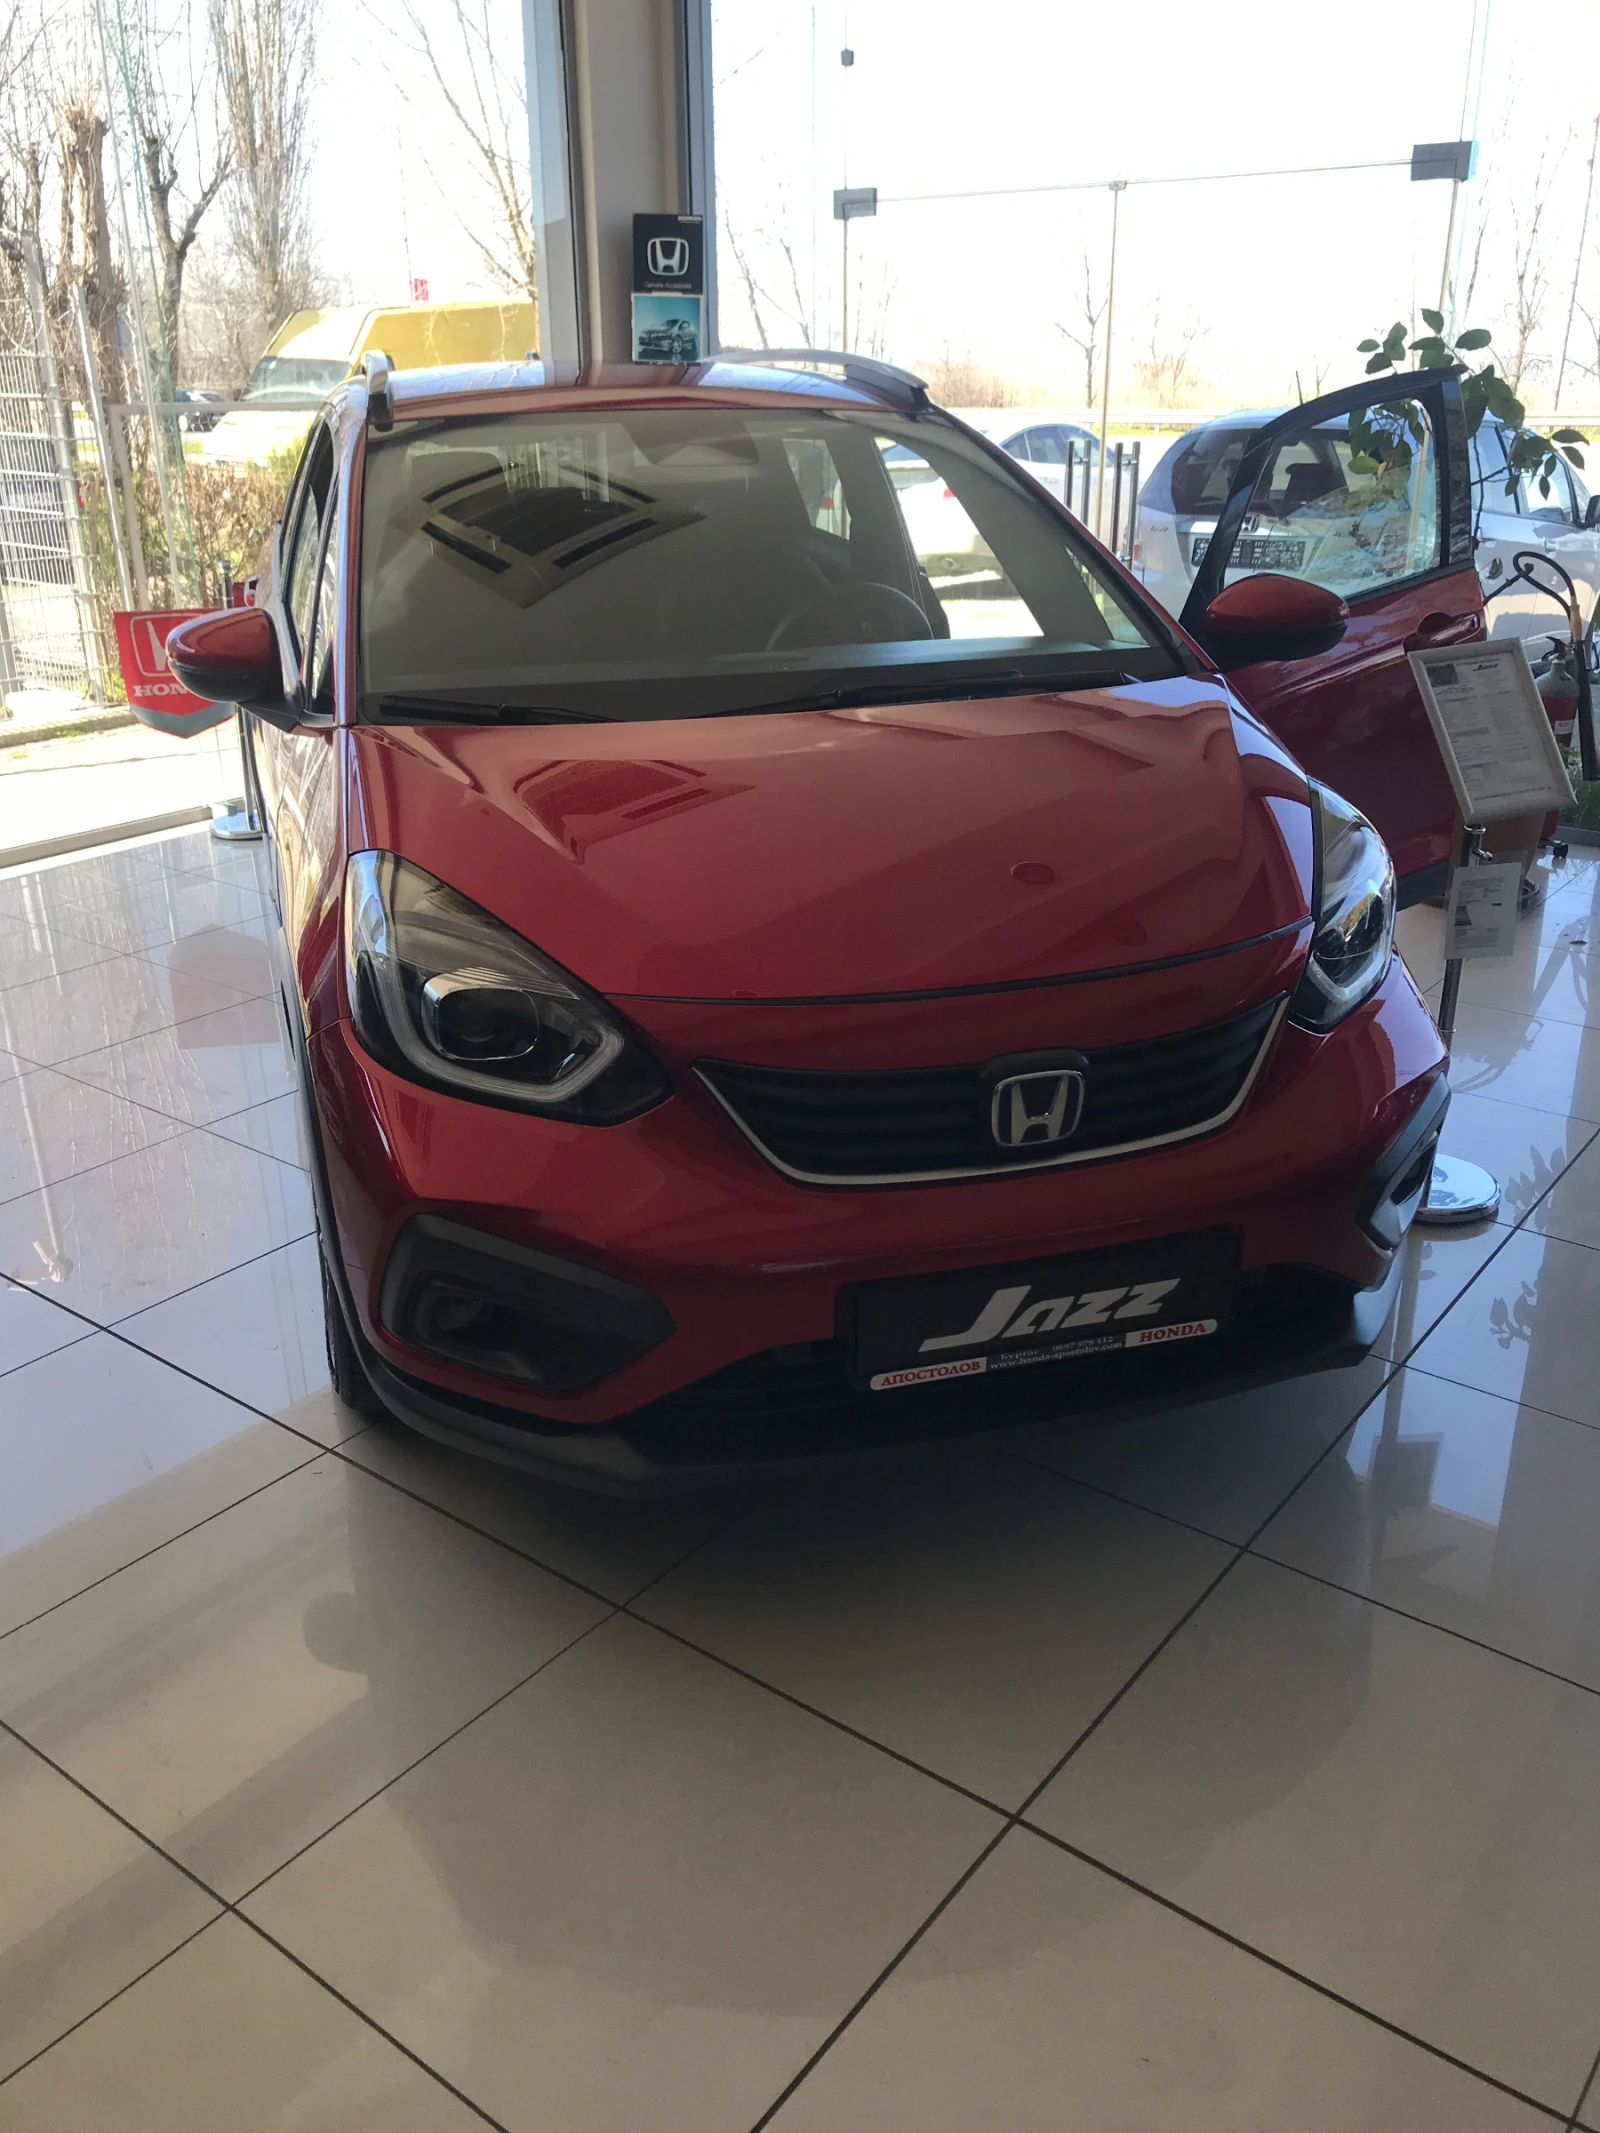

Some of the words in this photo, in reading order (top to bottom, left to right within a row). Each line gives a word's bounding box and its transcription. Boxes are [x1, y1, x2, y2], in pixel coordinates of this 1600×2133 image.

[133, 683, 188, 697] HON
[918, 1278, 1182, 1353] Jazz
[1139, 1321, 1208, 1344] HONDA
[989, 1342, 1123, 1370] www.honda-apostolov.com
[881, 1361, 981, 1388] АПОСТОЛОВ
